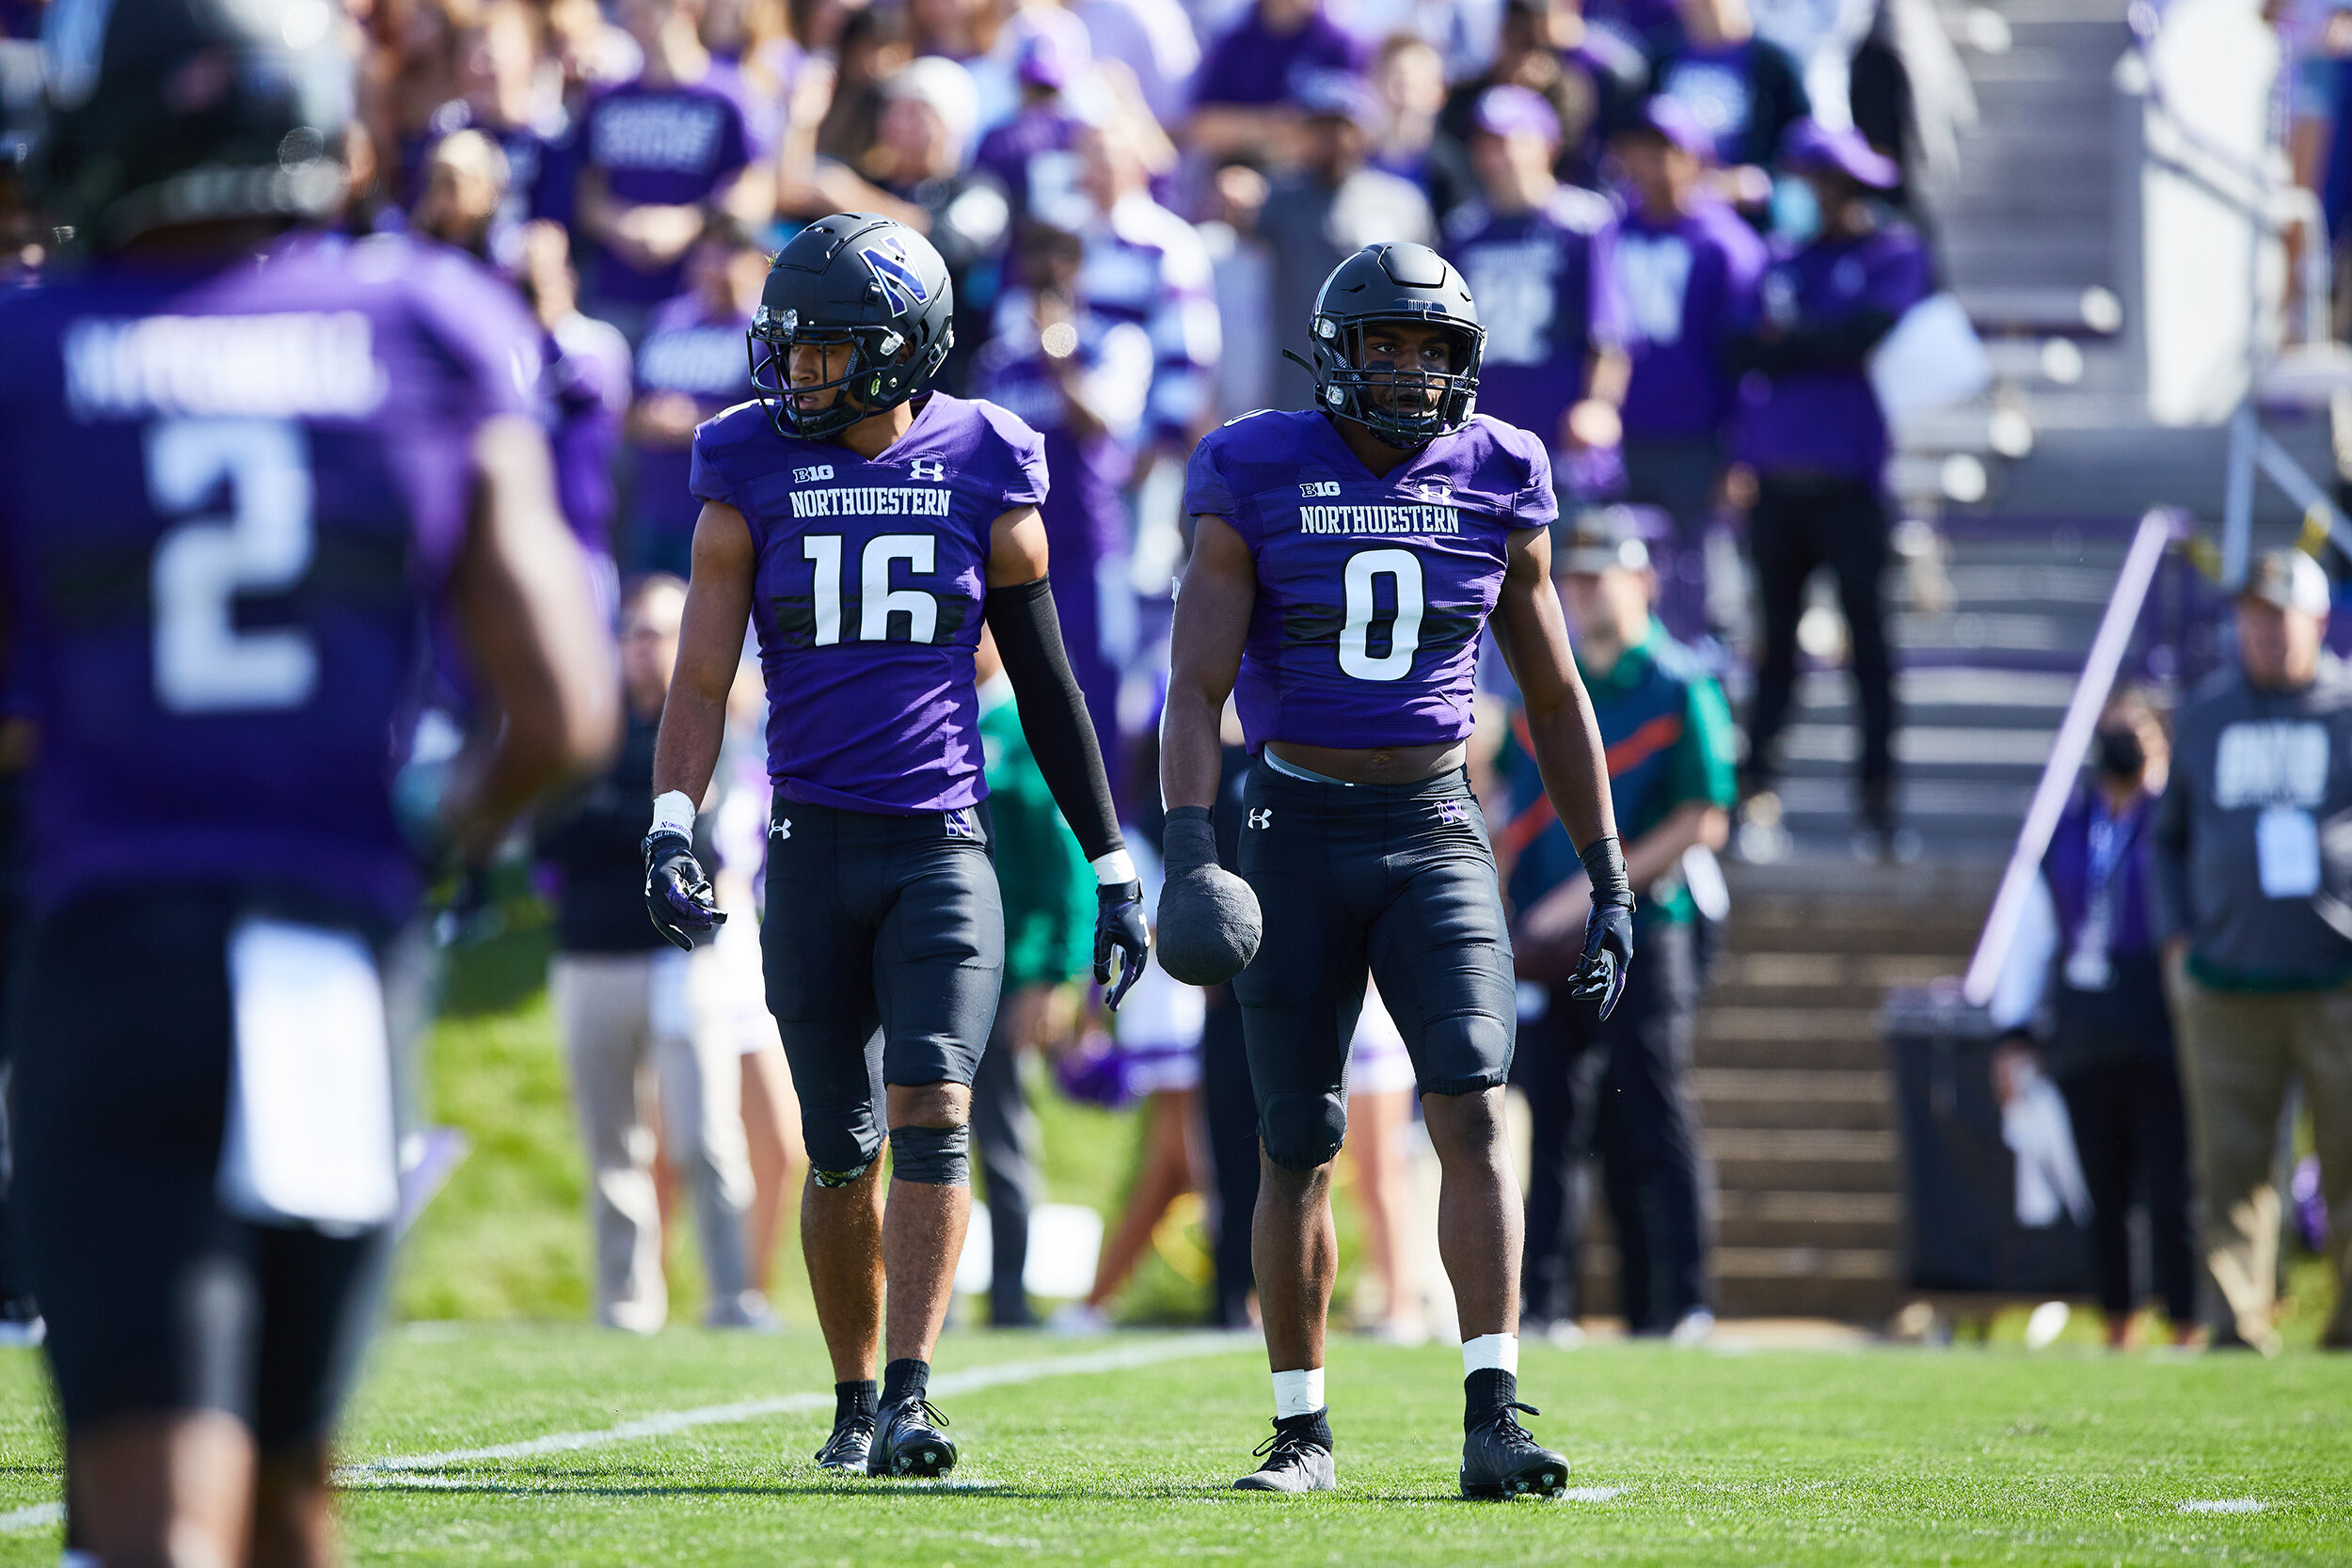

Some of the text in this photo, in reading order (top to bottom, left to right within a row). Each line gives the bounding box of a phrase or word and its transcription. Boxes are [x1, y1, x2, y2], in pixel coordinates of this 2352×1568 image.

[789, 487, 952, 518] NORTHWESTERN
[1299, 505, 1459, 534] NORTHWESTERN
[145, 419, 317, 713] 2
[803, 534, 938, 646] 16
[1339, 548, 1423, 681] 0
